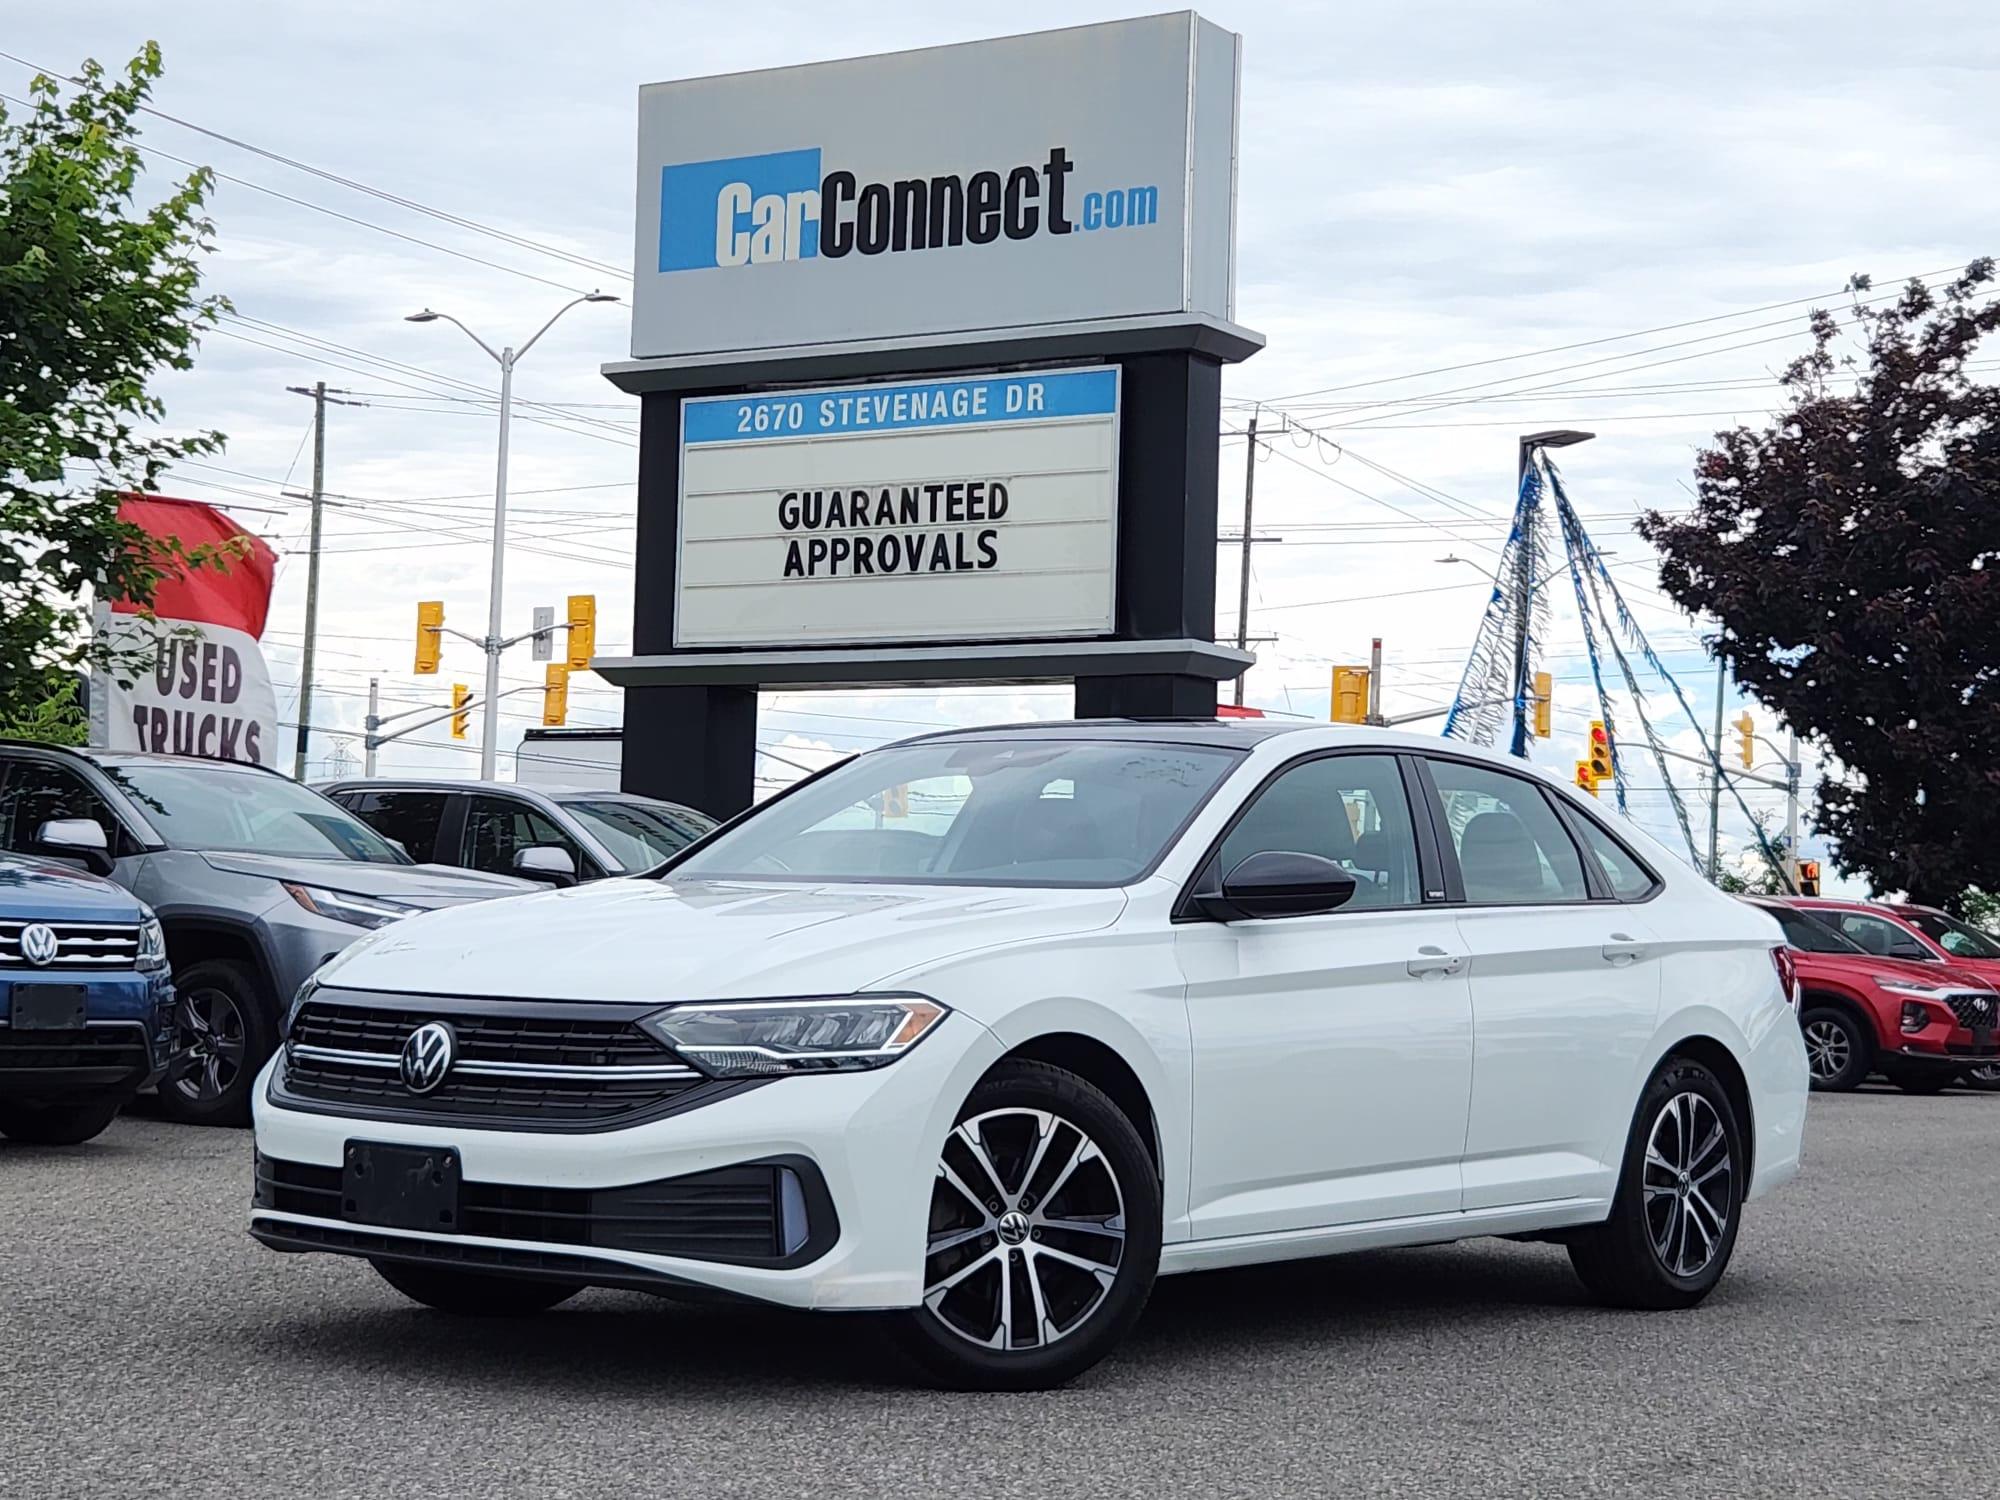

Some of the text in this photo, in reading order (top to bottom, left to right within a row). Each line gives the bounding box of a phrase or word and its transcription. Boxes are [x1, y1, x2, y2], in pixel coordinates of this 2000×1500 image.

[737, 383, 1045, 432] 2670 STEVENAGE DR
[778, 482, 1009, 530] GUARANTEED
[783, 529, 998, 577] APPROVALS
[156, 637, 242, 704] USED
[133, 704, 261, 763] TRUCKS
